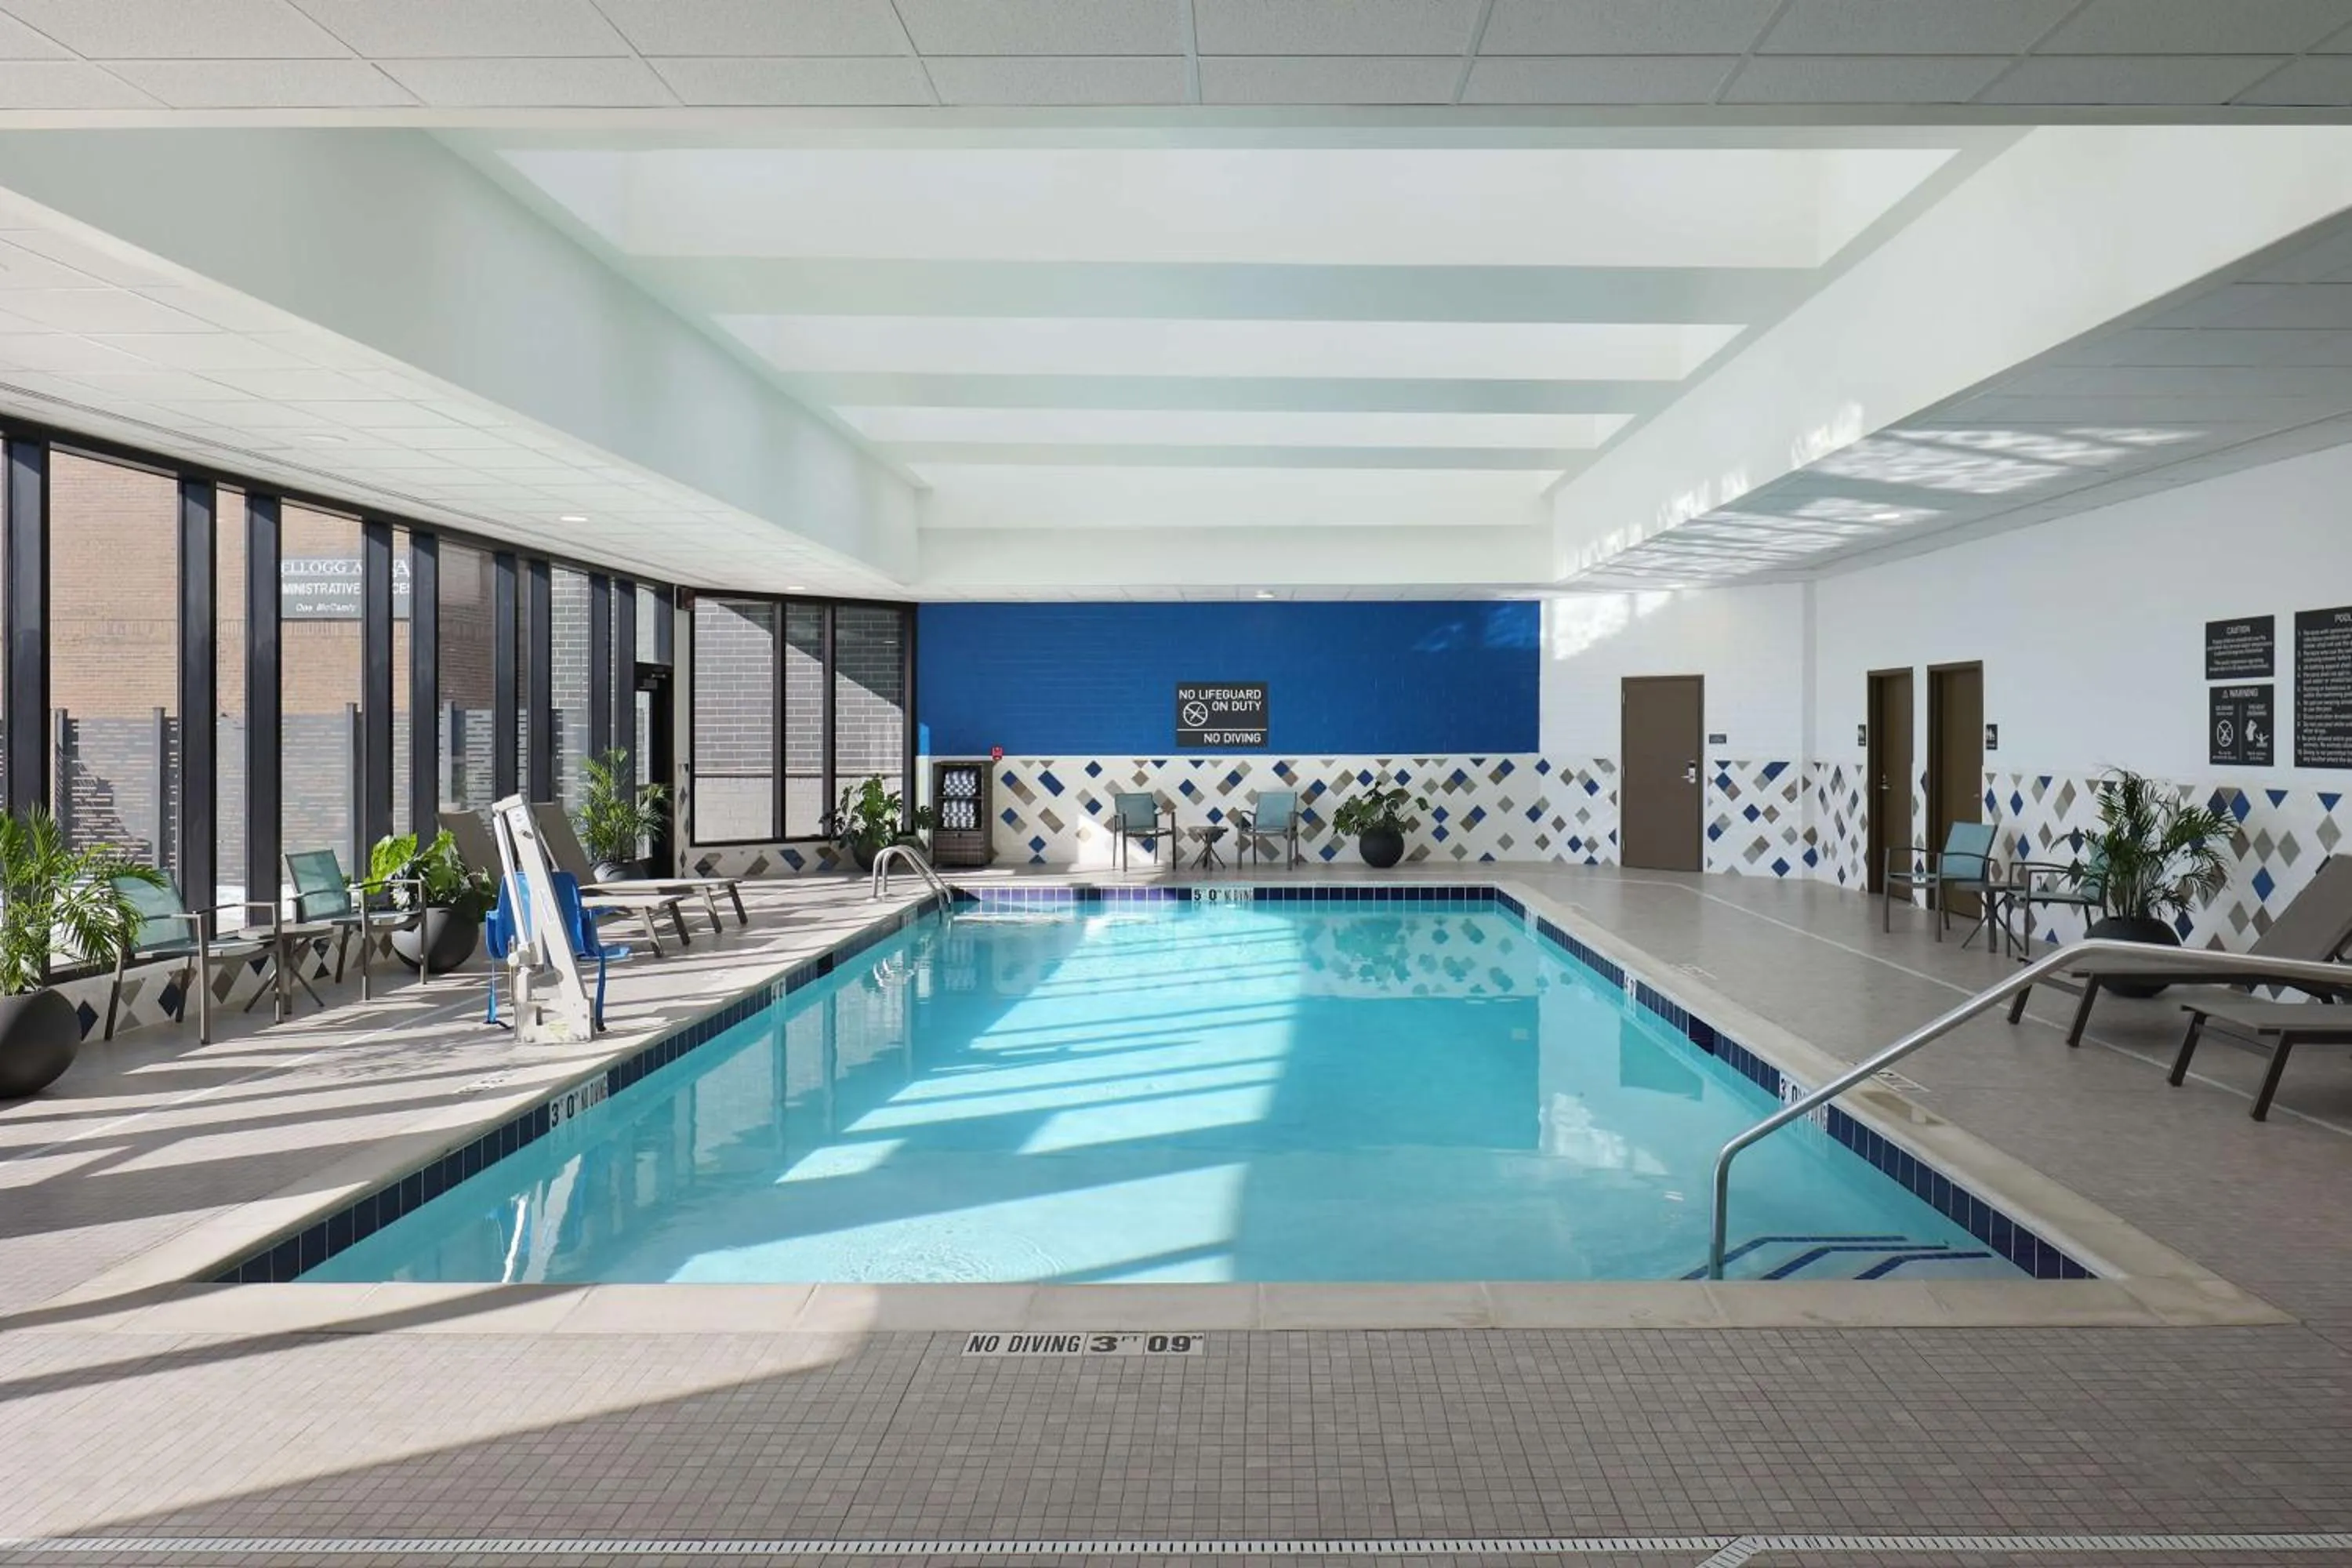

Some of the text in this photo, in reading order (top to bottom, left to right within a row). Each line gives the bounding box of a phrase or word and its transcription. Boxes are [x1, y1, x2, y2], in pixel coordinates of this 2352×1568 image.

[281, 561, 347, 574] ELLOGG
[282, 583, 361, 594] MINISTRATIVE
[1178, 689, 1261, 700] NO LIFEGUARD
[1211, 701, 1261, 711] ON DUTY
[1203, 732, 1261, 744] NO DIVING
[967, 1335, 1000, 1353] NO
[1007, 1335, 1081, 1353] DIVING
